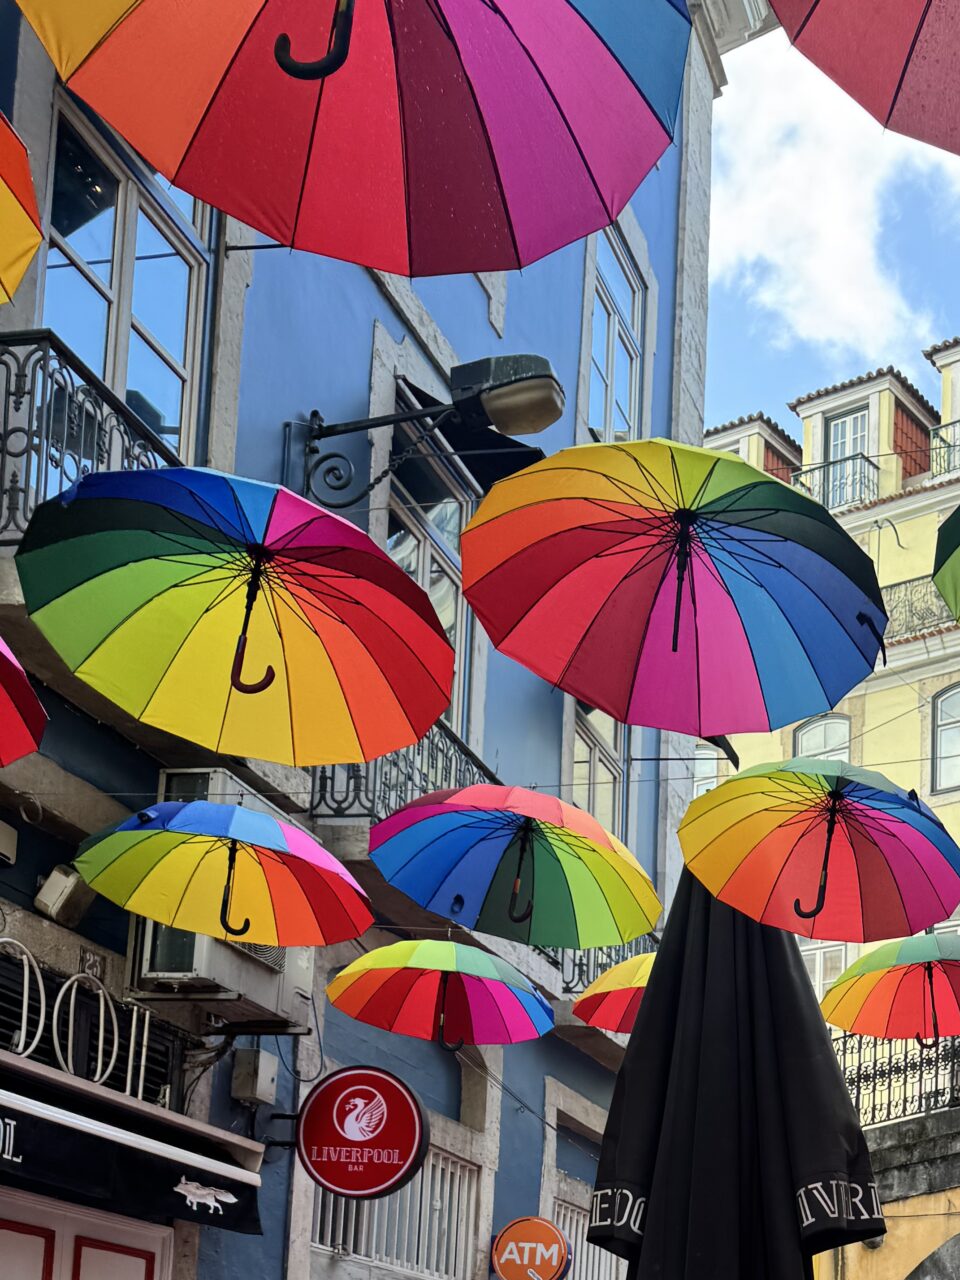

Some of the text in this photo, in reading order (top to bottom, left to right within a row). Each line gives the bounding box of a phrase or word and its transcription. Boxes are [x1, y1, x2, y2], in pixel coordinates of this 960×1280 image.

[311, 1146, 404, 1164] LIVERPOOL
[347, 1164, 364, 1172] BAR
[499, 1241, 559, 1267] ATM
